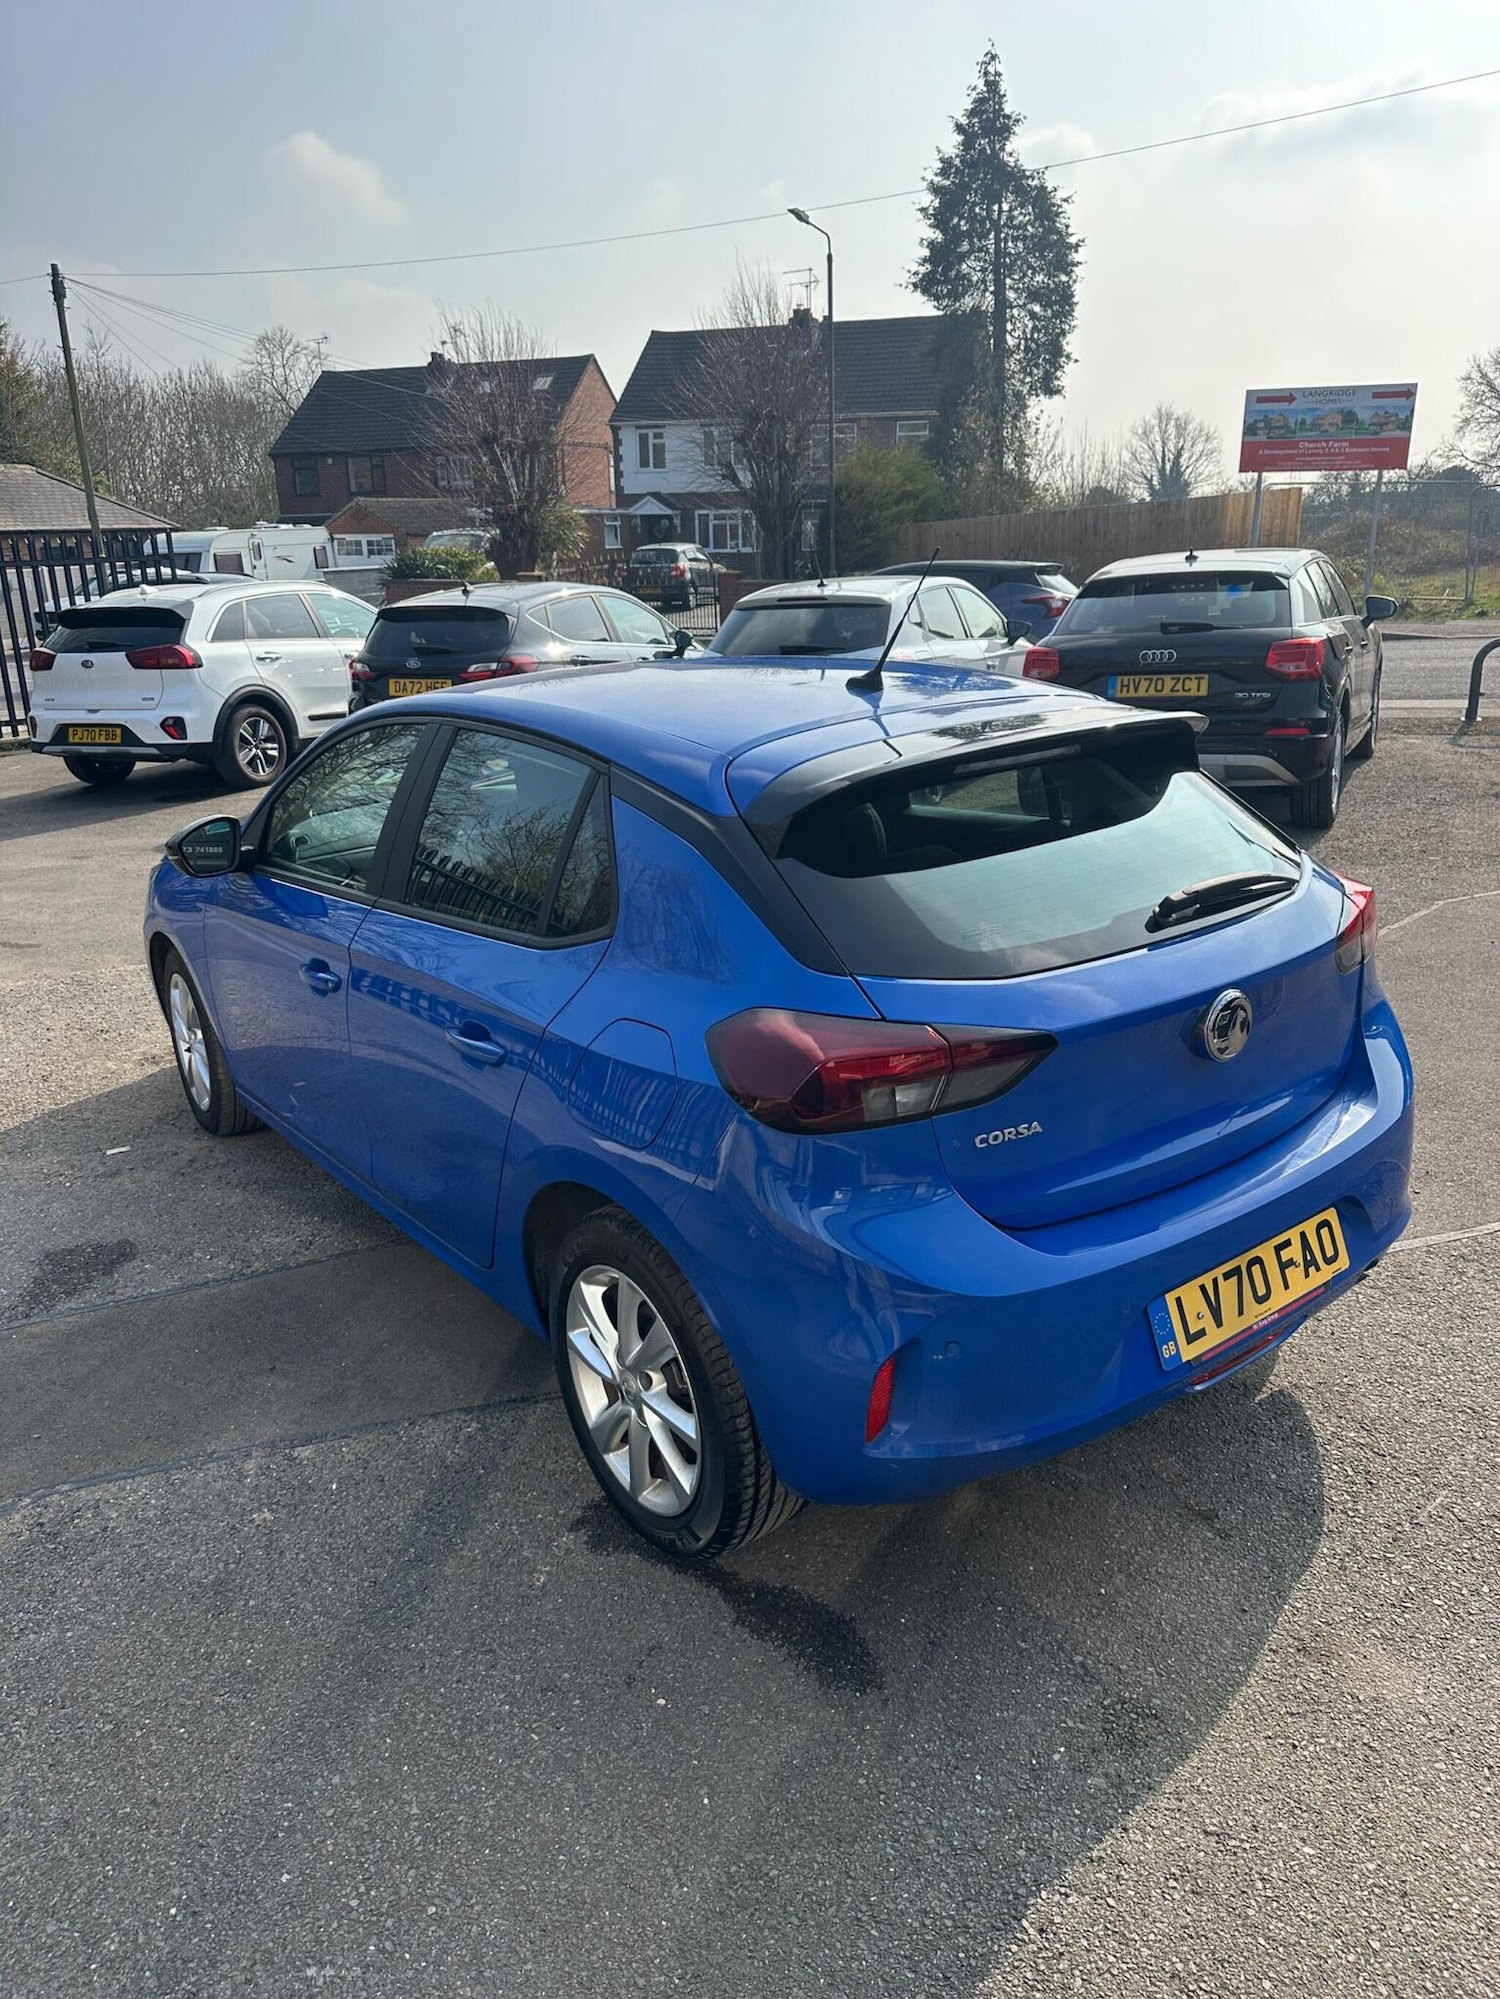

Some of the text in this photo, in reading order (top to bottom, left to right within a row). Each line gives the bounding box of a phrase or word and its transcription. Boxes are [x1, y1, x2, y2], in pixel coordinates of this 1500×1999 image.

[1302, 389, 1357, 398] LANGRIDGE
[1299, 441, 1327, 449] Church
[394, 681, 423, 694] DA72
[1119, 676, 1205, 694] HV70 ZCT
[72, 729, 117, 741] PJ70 FBB
[974, 1121, 1043, 1148] CORSA
[1175, 1218, 1340, 1346] LV70 FAO
[1162, 1340, 1177, 1359] GB
